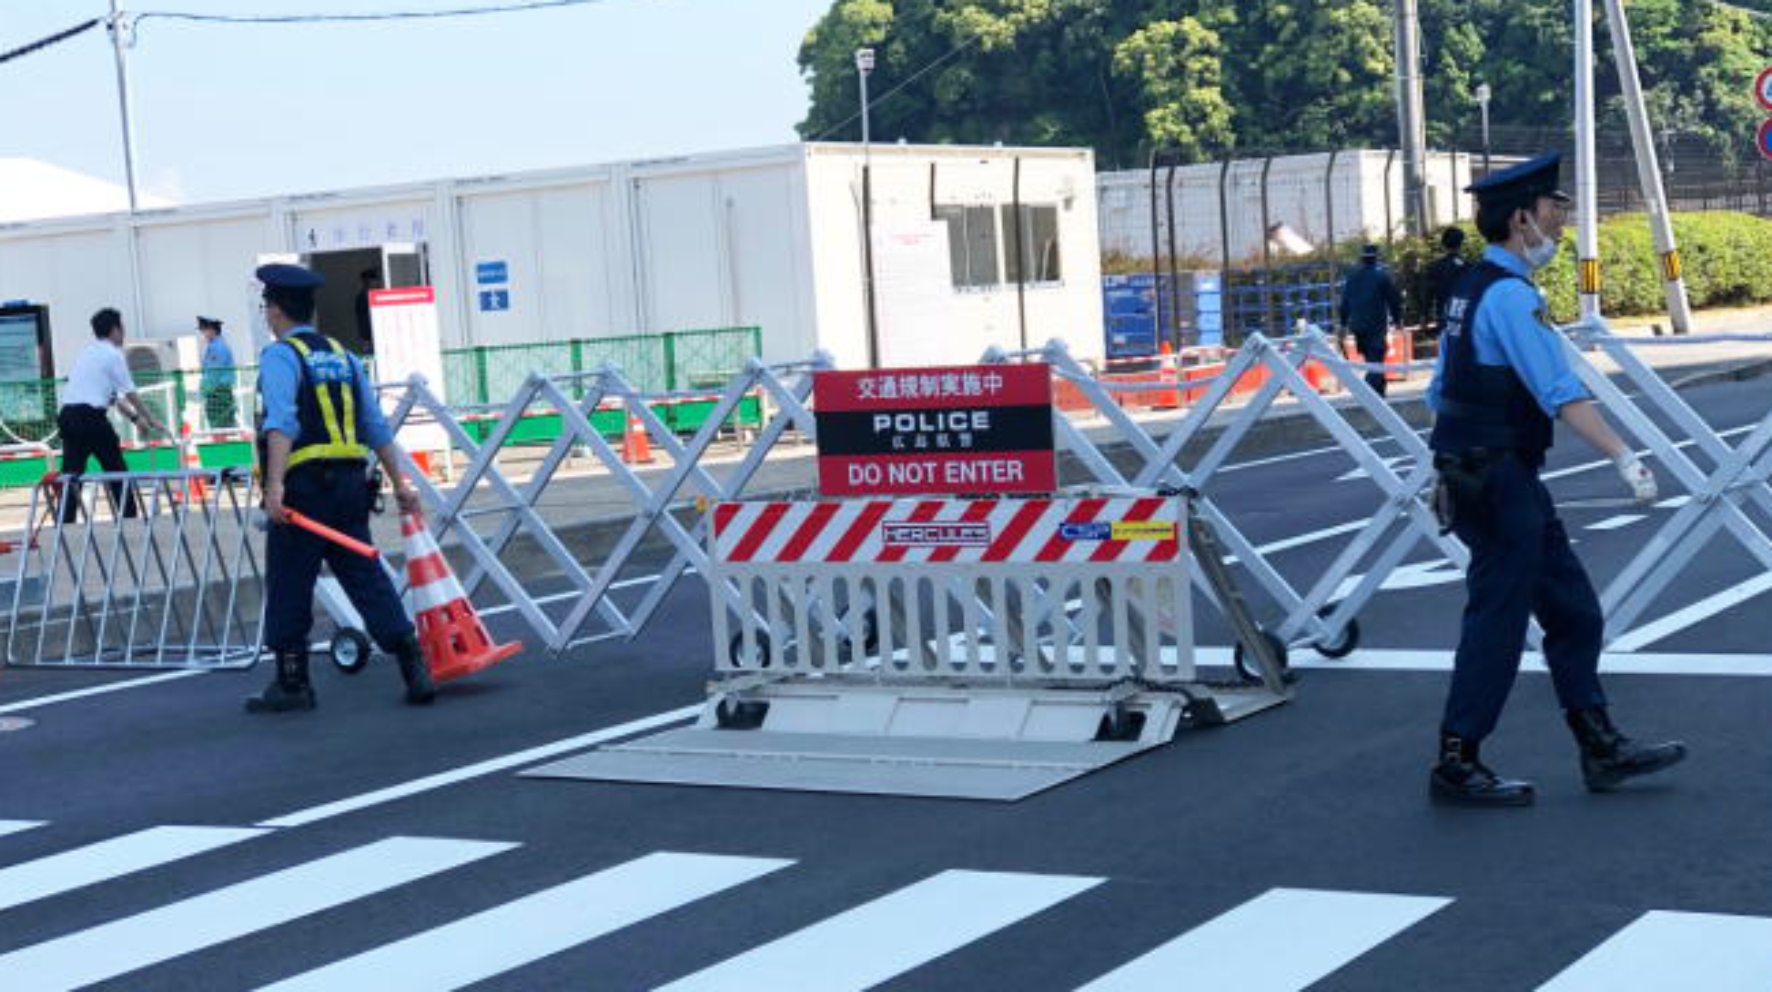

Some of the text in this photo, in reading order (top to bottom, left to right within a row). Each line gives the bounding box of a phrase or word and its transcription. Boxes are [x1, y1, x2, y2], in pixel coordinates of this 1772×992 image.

[857, 371, 1003, 399] 交通規制実施中
[873, 411, 990, 432] POLICE
[848, 460, 1024, 485] DO NOT ENTER
[883, 527, 989, 542] HERCULES
